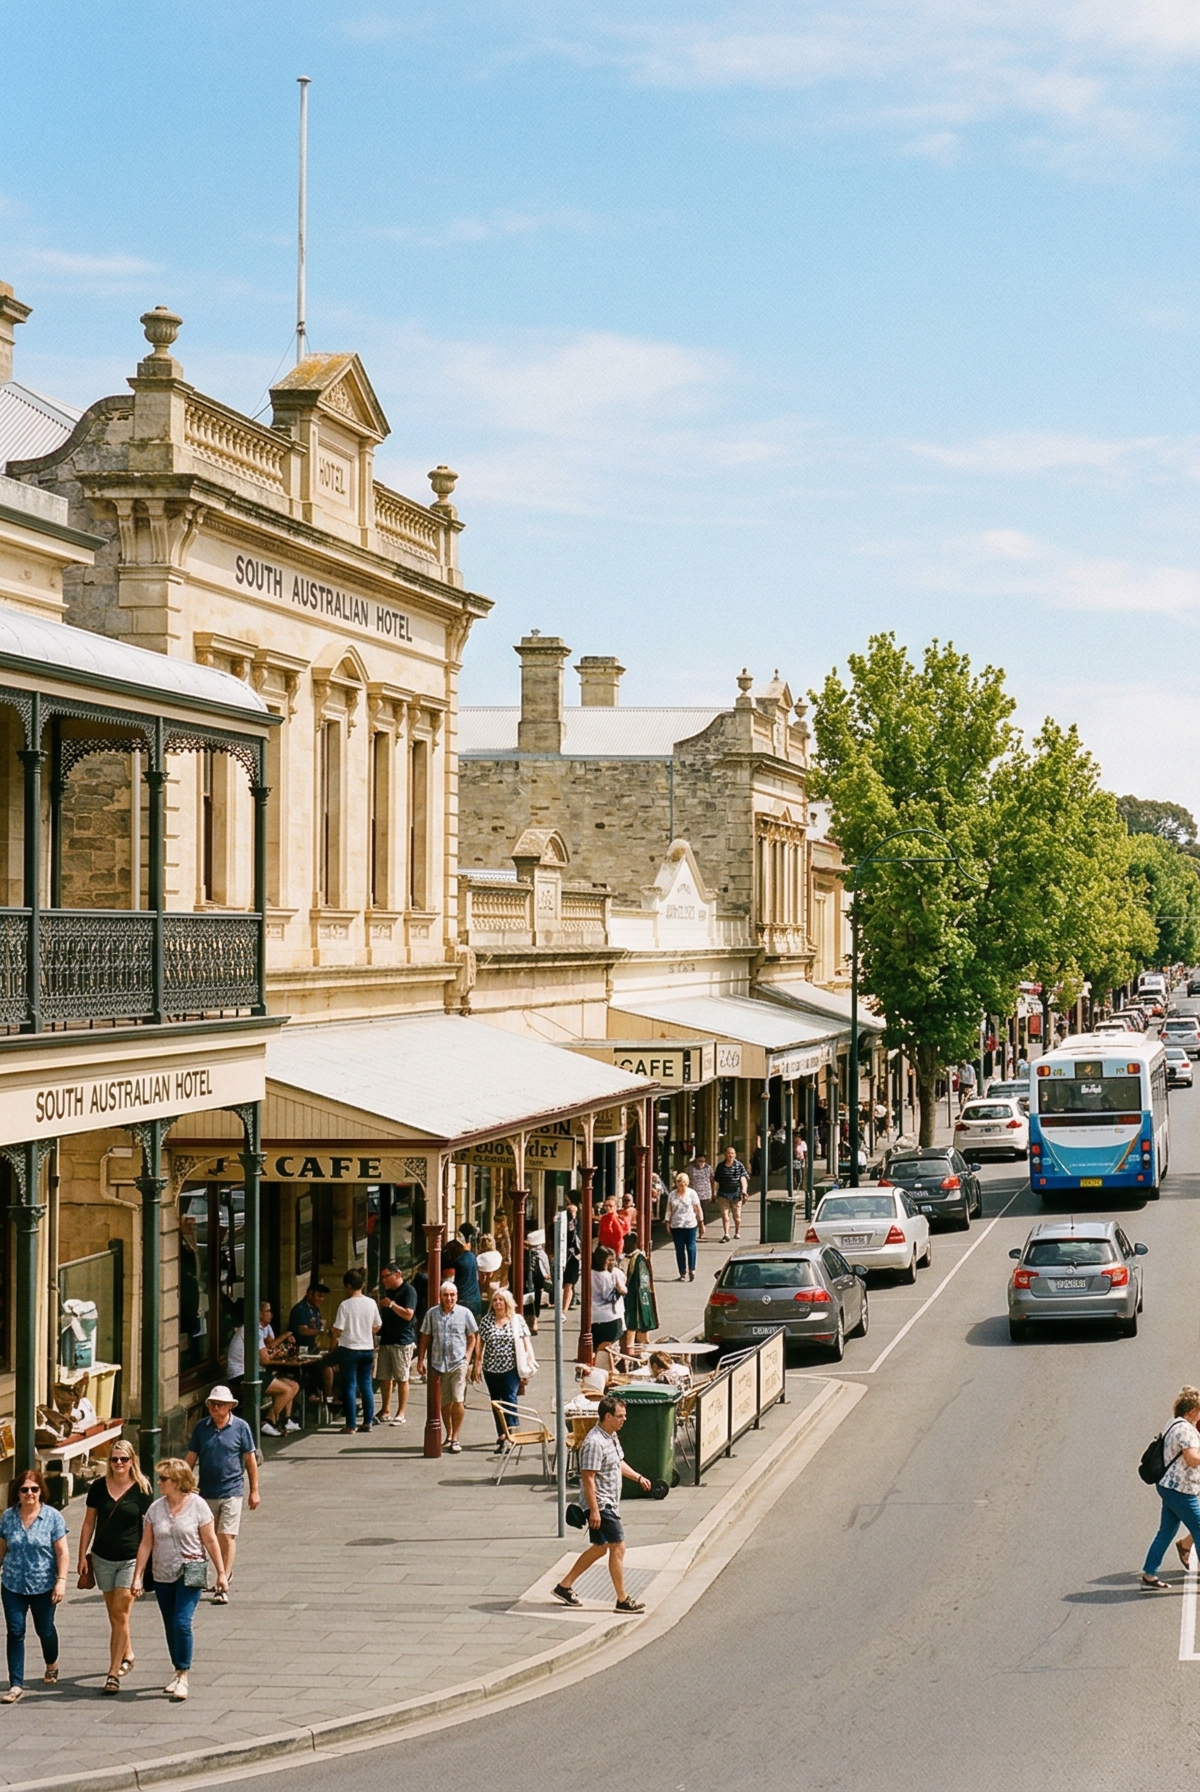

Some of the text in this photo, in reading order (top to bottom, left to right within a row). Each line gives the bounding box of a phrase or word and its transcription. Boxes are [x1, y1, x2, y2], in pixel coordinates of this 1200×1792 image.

[319, 456, 345, 495] HOTEL
[235, 554, 413, 643] SOUTH AUSTRALIAN HOTEL
[35, 1069, 213, 1123] SOUTH AUSTRALIAN HOTEL
[274, 1156, 382, 1179] CAFE
